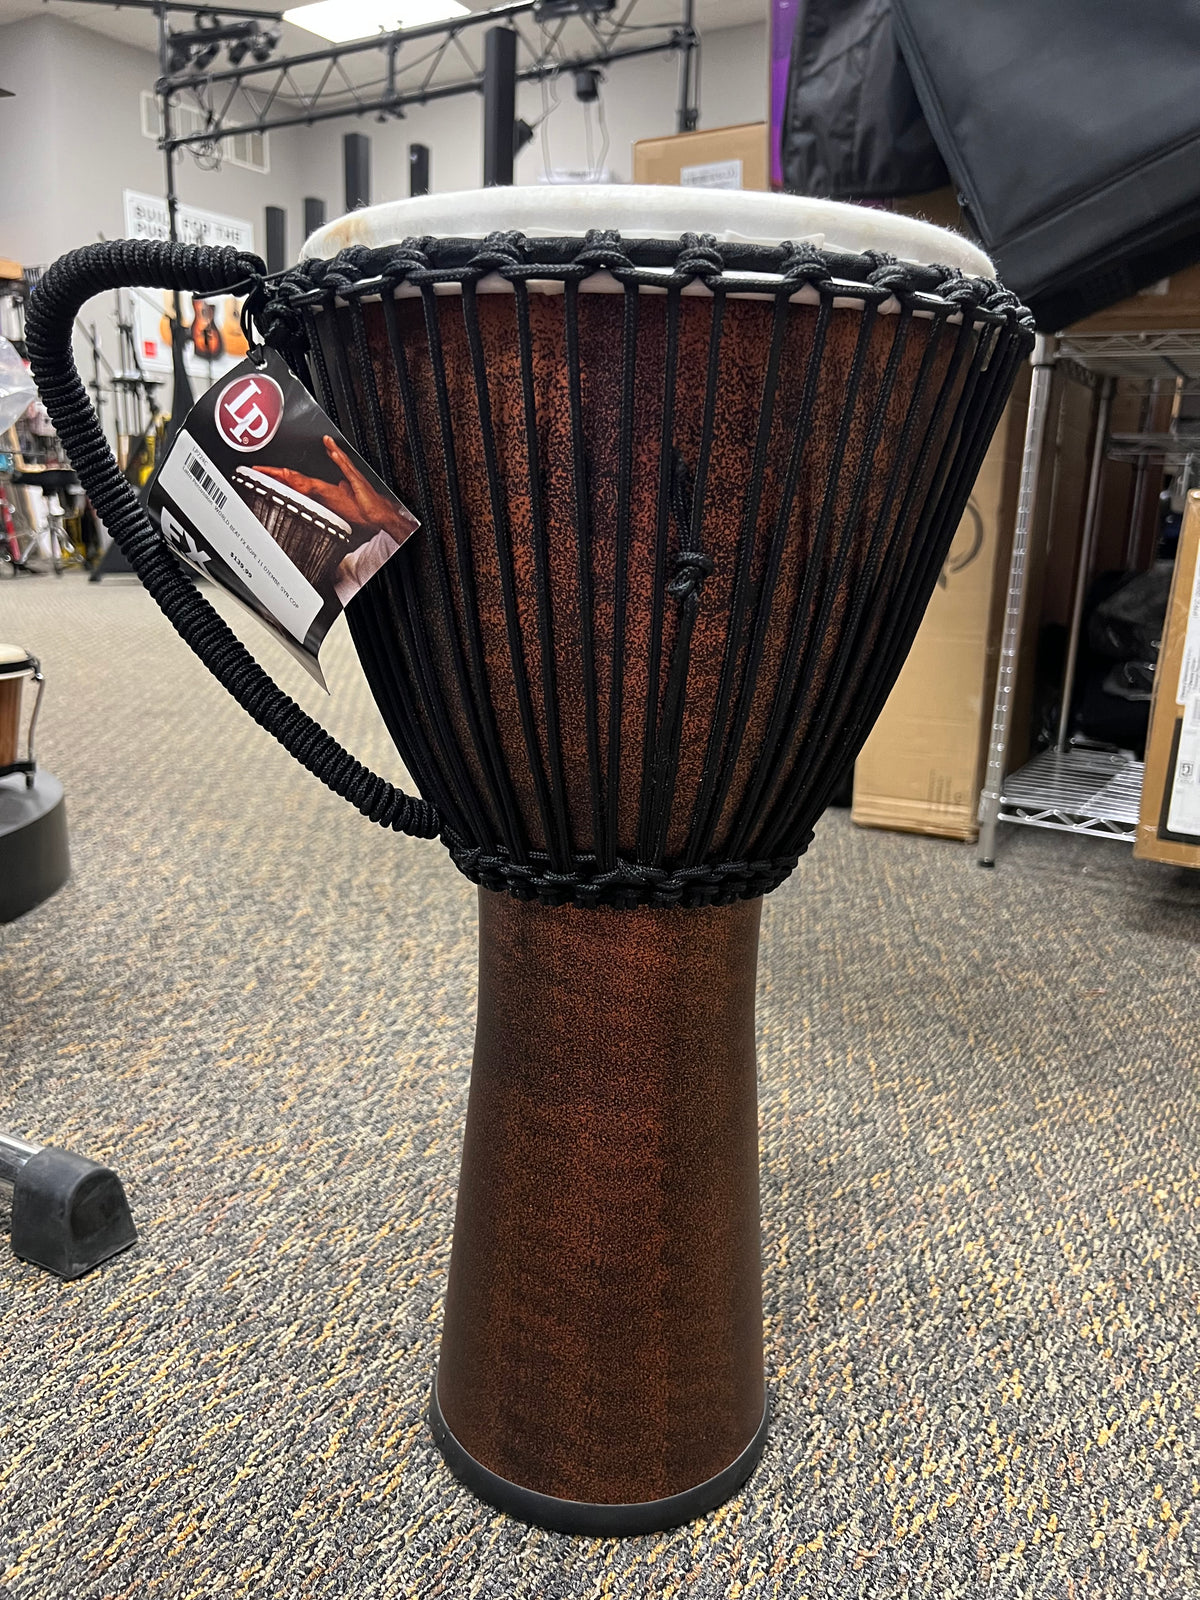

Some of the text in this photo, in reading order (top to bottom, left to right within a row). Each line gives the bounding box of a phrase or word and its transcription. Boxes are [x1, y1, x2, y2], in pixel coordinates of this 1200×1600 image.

[136, 205, 241, 244] BUIL FOR THE
[214, 505, 230, 526] WORLD
[229, 524, 241, 538] BEAT
[240, 537, 247, 547] FX
[245, 544, 257, 559] ROPE
[263, 565, 281, 586] DJEMBE
[229, 551, 253, 579] $139.99
